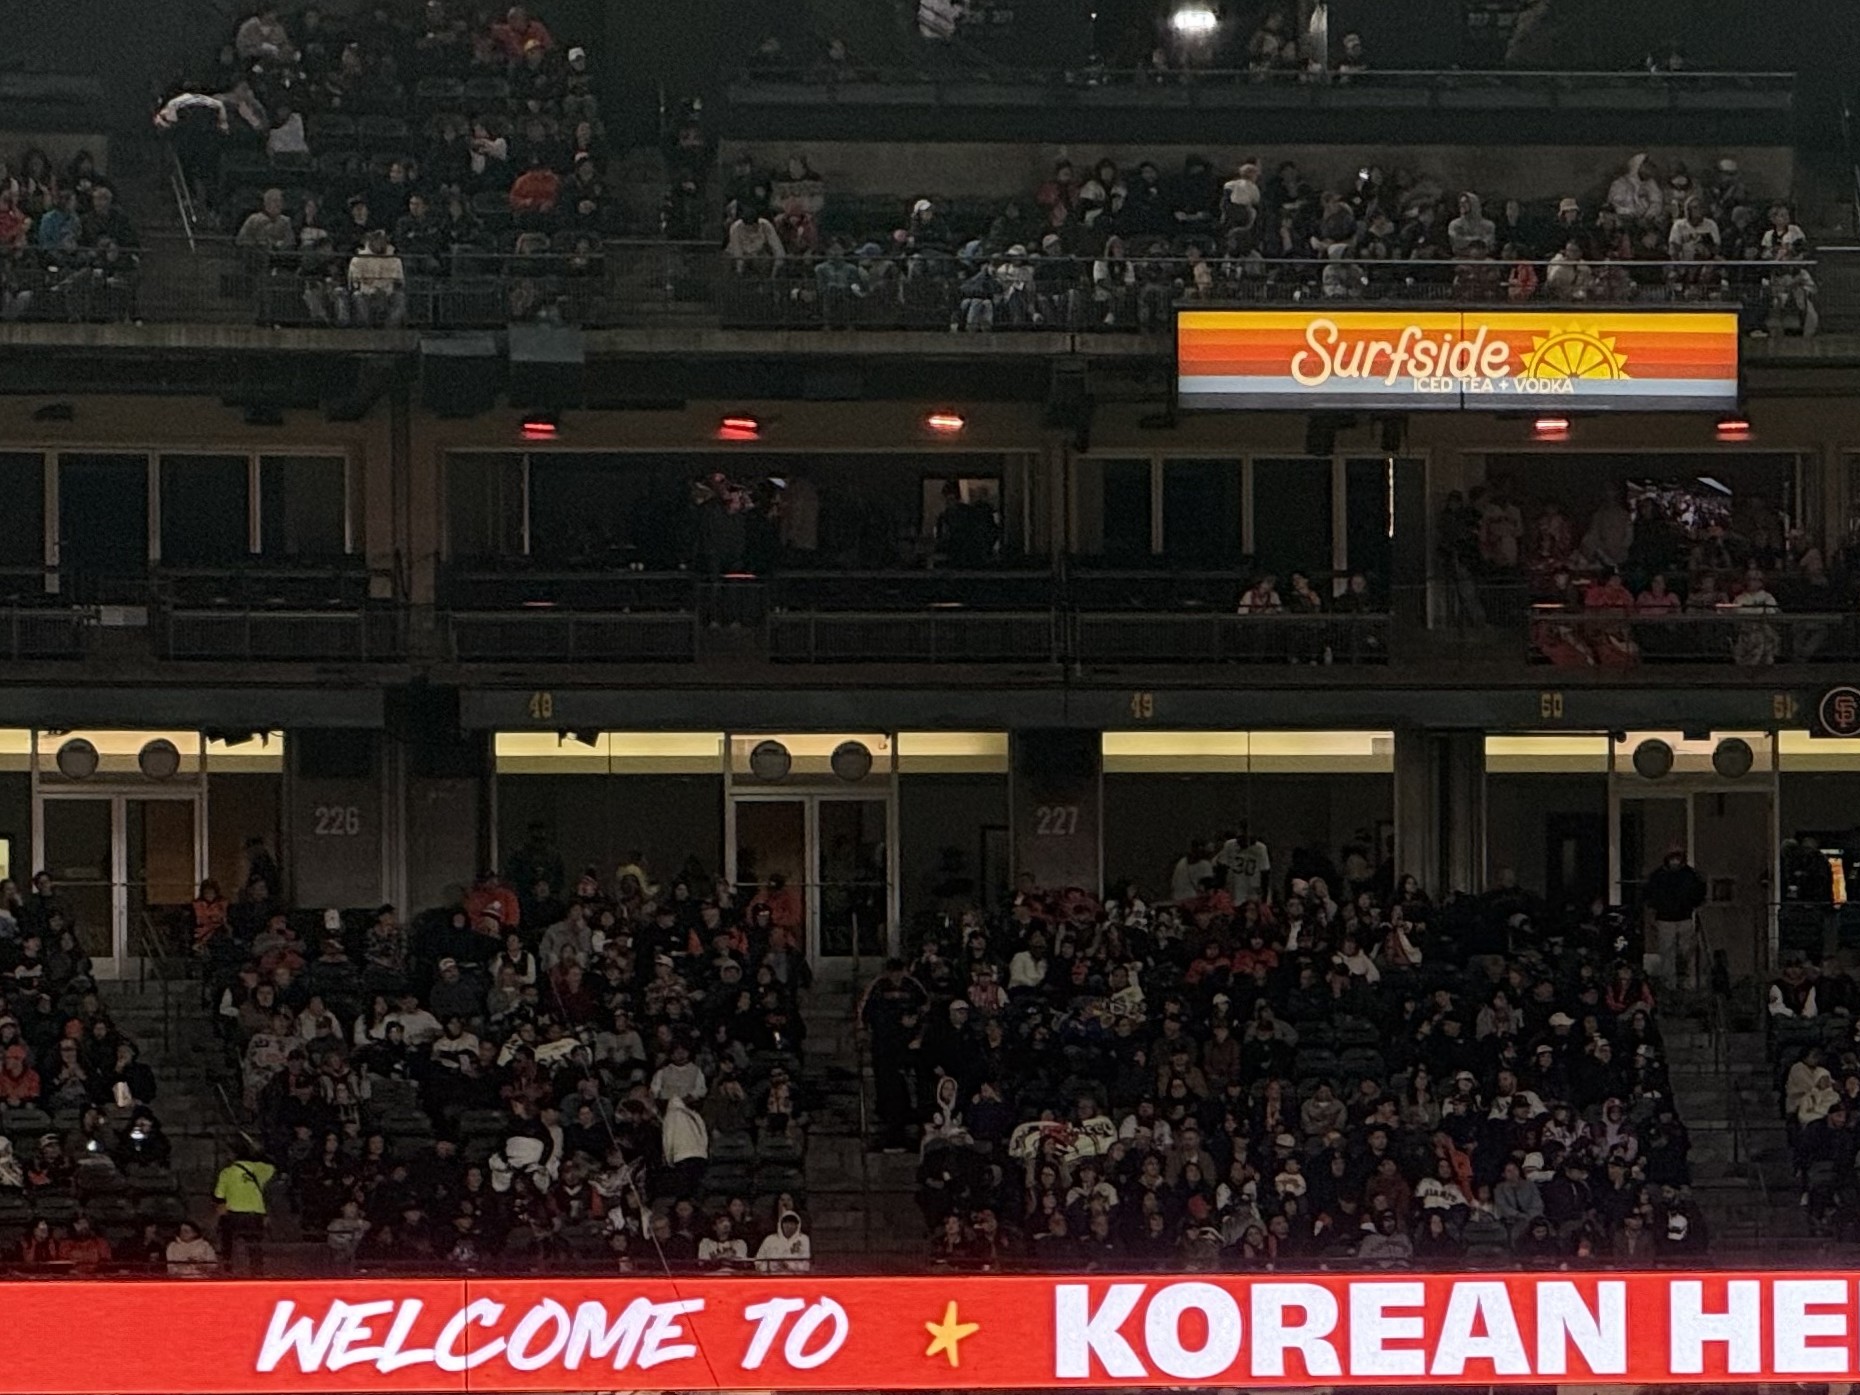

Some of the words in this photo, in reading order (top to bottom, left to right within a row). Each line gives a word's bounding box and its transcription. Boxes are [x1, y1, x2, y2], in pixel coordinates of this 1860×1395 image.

[1291, 318, 1510, 386] Surfside
[1413, 378, 1453, 393] ICED
[1461, 378, 1494, 393] TEA
[1513, 378, 1574, 393] VODKA
[315, 806, 359, 835] 226
[1037, 806, 1079, 835] 227
[256, 1297, 705, 1373] WELCOME
[741, 1295, 849, 1371] TO
[1055, 1280, 1626, 1378] KOREAN
